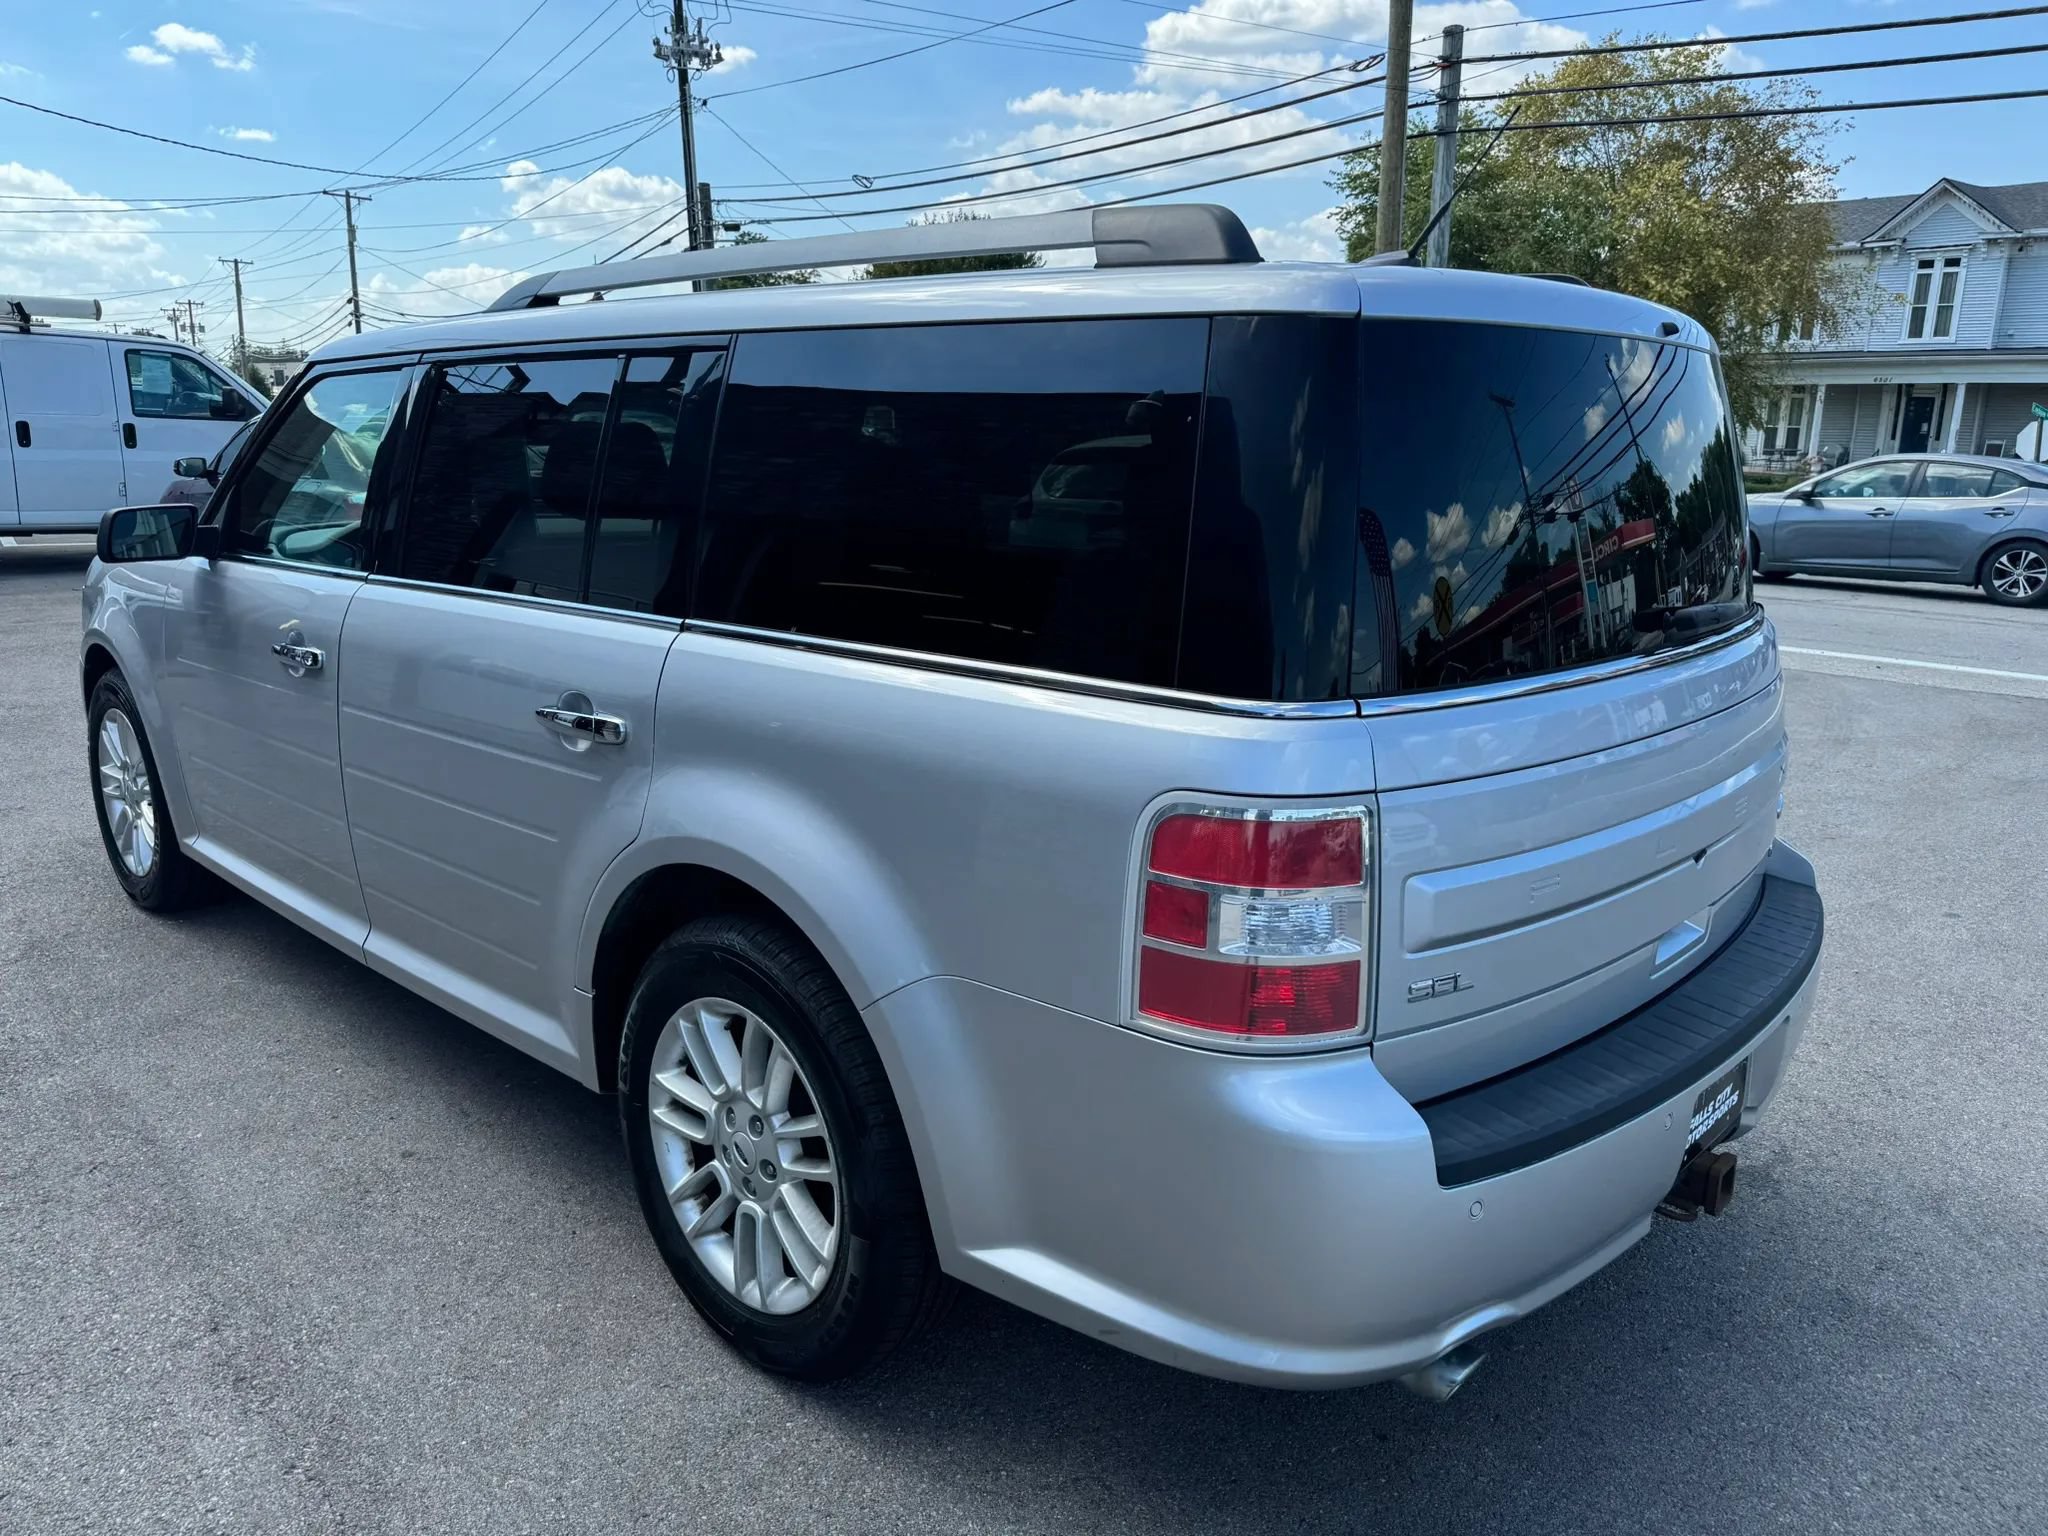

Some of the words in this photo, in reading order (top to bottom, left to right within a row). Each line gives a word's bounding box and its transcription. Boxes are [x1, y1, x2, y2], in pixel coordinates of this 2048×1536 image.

[1407, 972, 1475, 1003] SEL
[1715, 1082, 1734, 1109] CITY
[1685, 1090, 1739, 1149] OTORSPORTS
